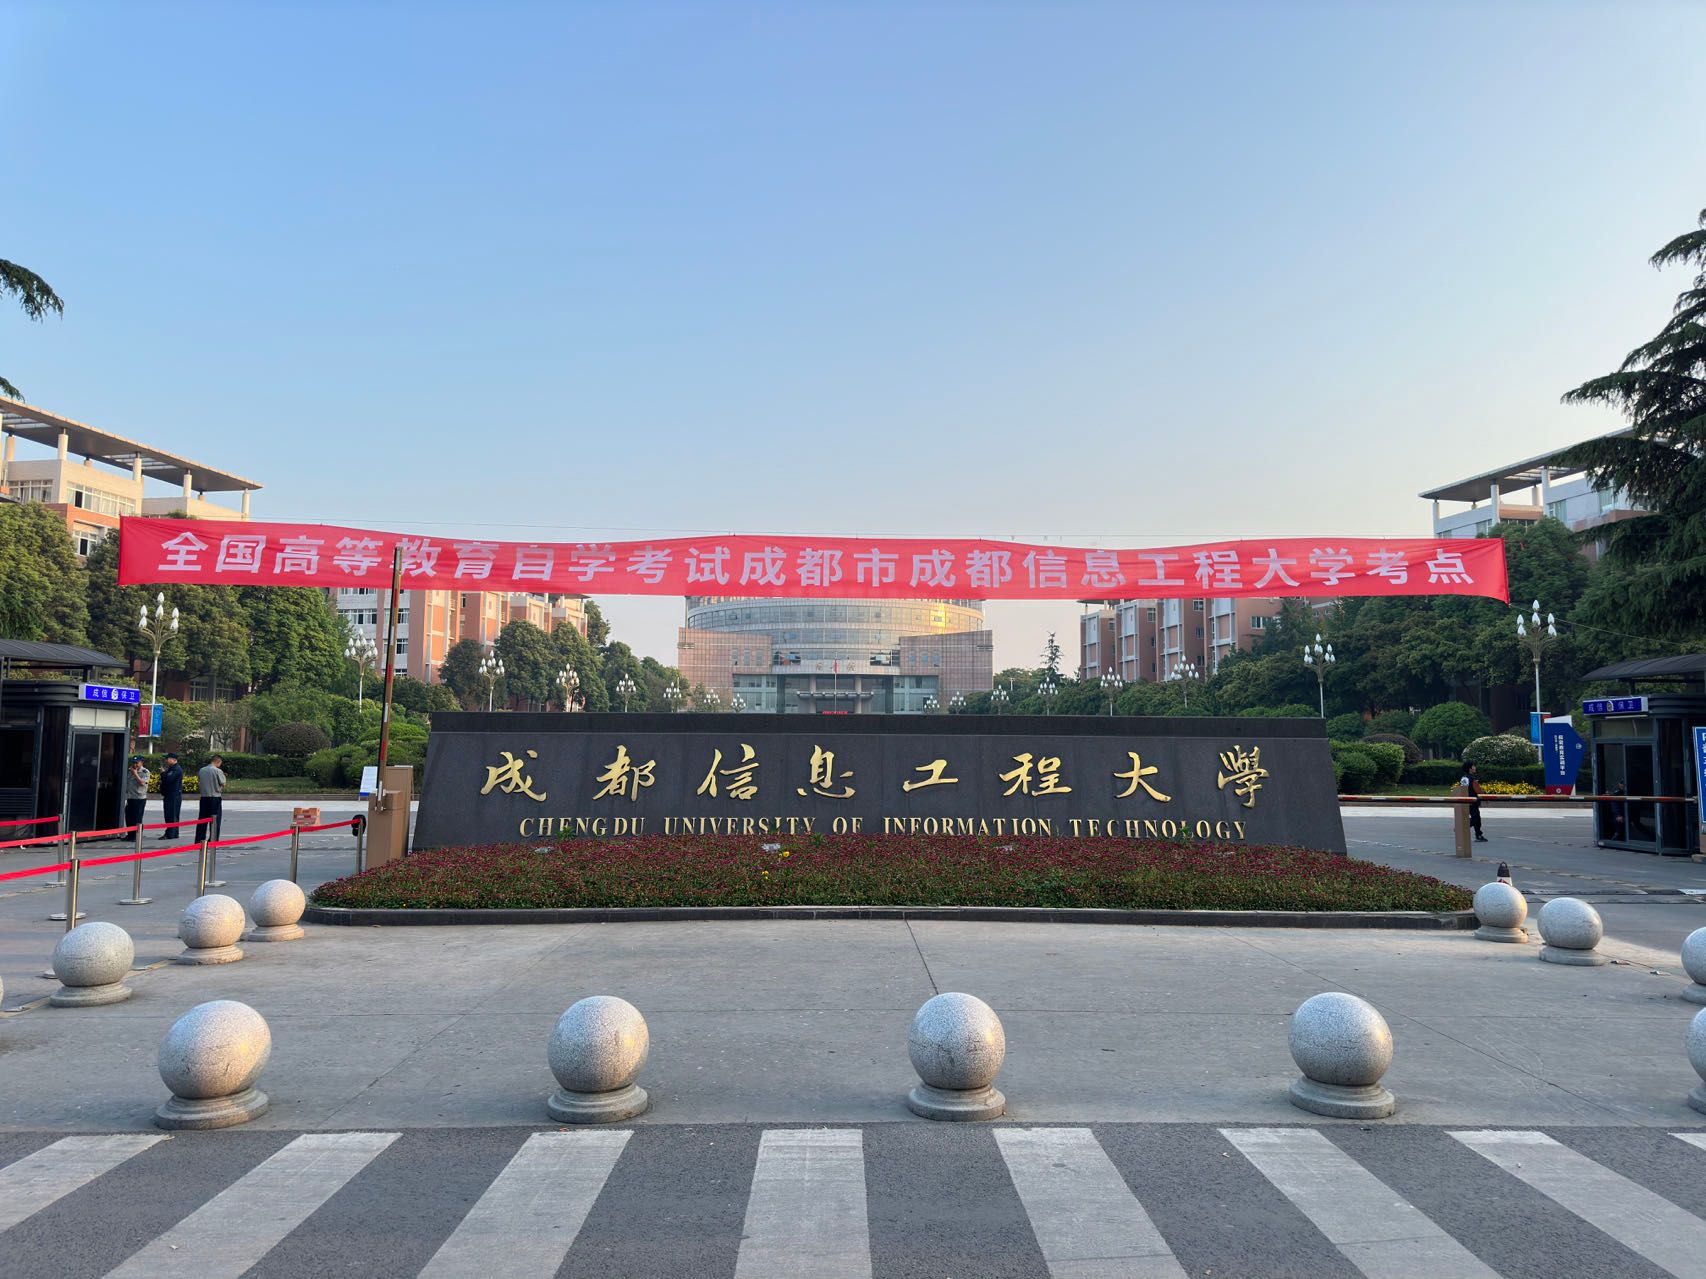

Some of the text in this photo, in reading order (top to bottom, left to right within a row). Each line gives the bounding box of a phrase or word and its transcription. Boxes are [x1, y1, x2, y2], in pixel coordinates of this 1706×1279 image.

[157, 530, 1475, 590] 全国高等教育自学考试成都市成都信息工程大学考点
[519, 816, 1247, 841] CHENGDU UNIVERSITY OF INFORMATION TECHNOLOGY
